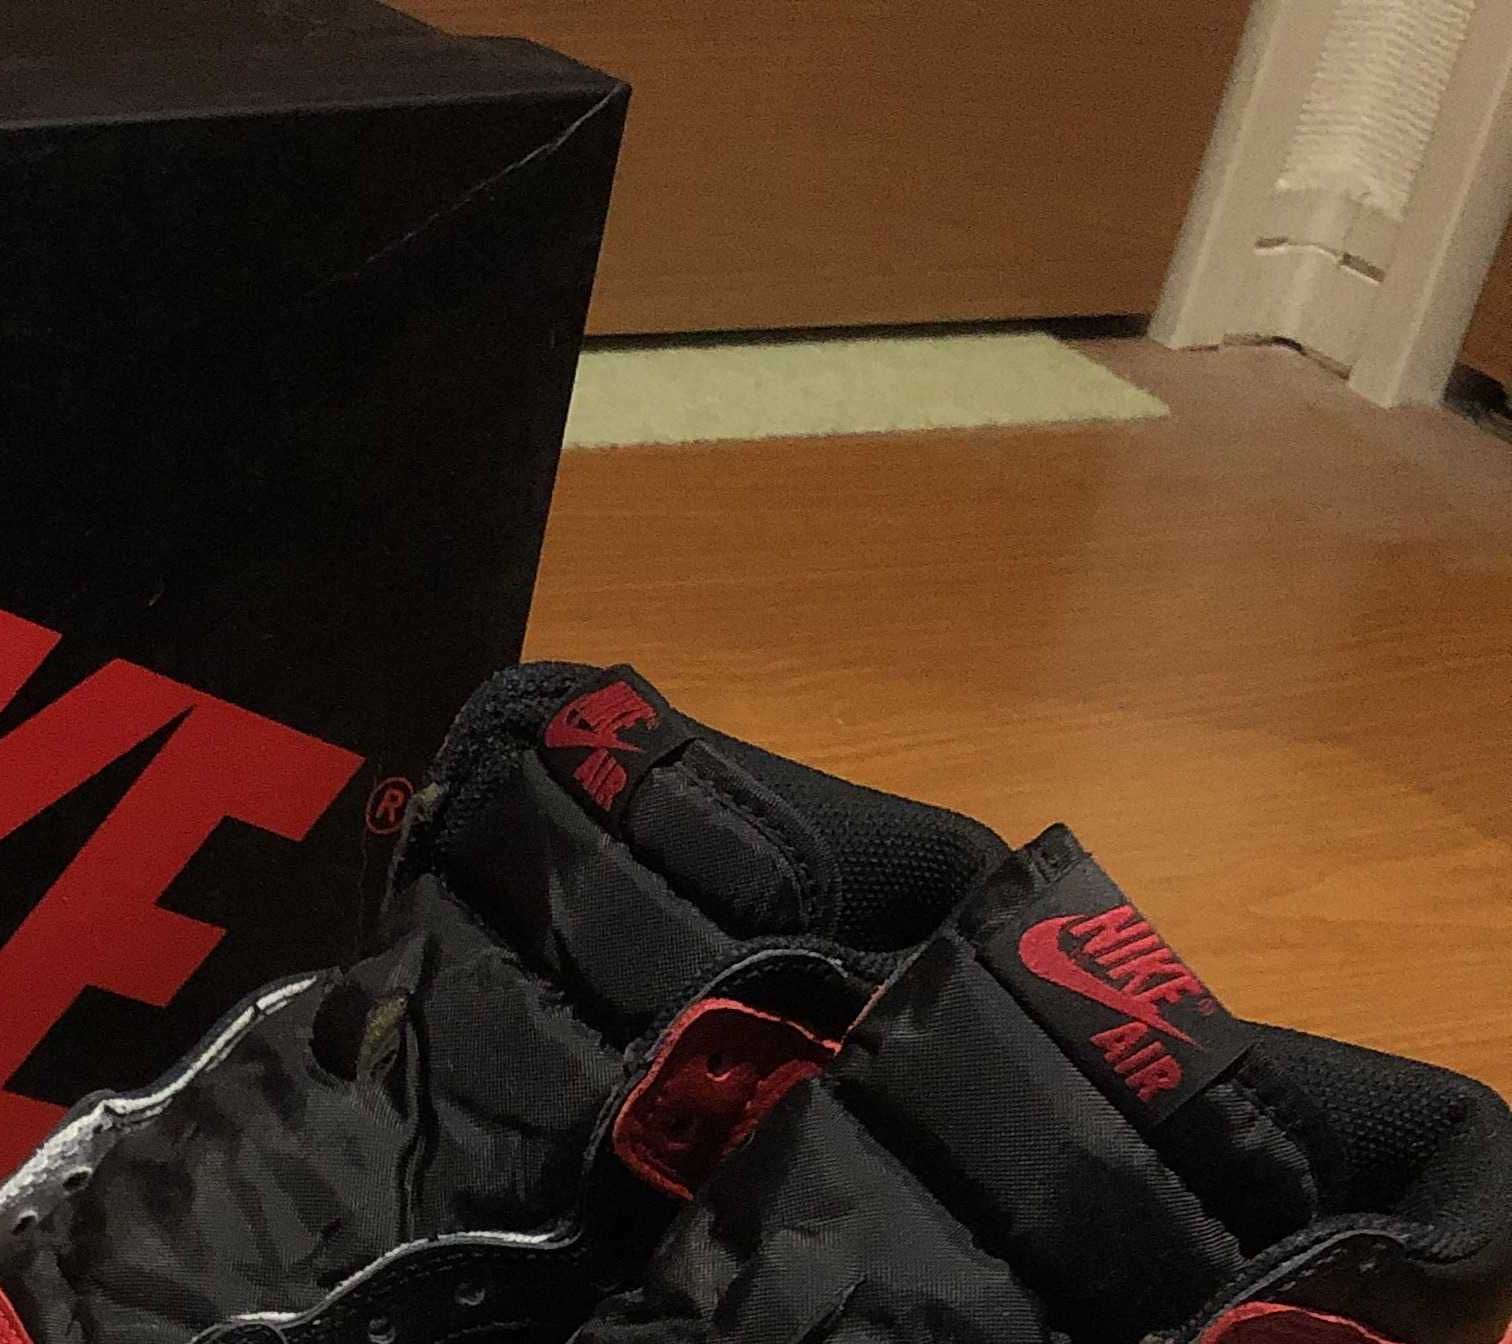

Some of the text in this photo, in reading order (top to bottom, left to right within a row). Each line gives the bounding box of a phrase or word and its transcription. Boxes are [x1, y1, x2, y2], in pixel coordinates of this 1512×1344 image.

[573, 750, 627, 812] AIR
[1068, 904, 1203, 1008] NIKE
[1090, 1021, 1182, 1101] AIR
